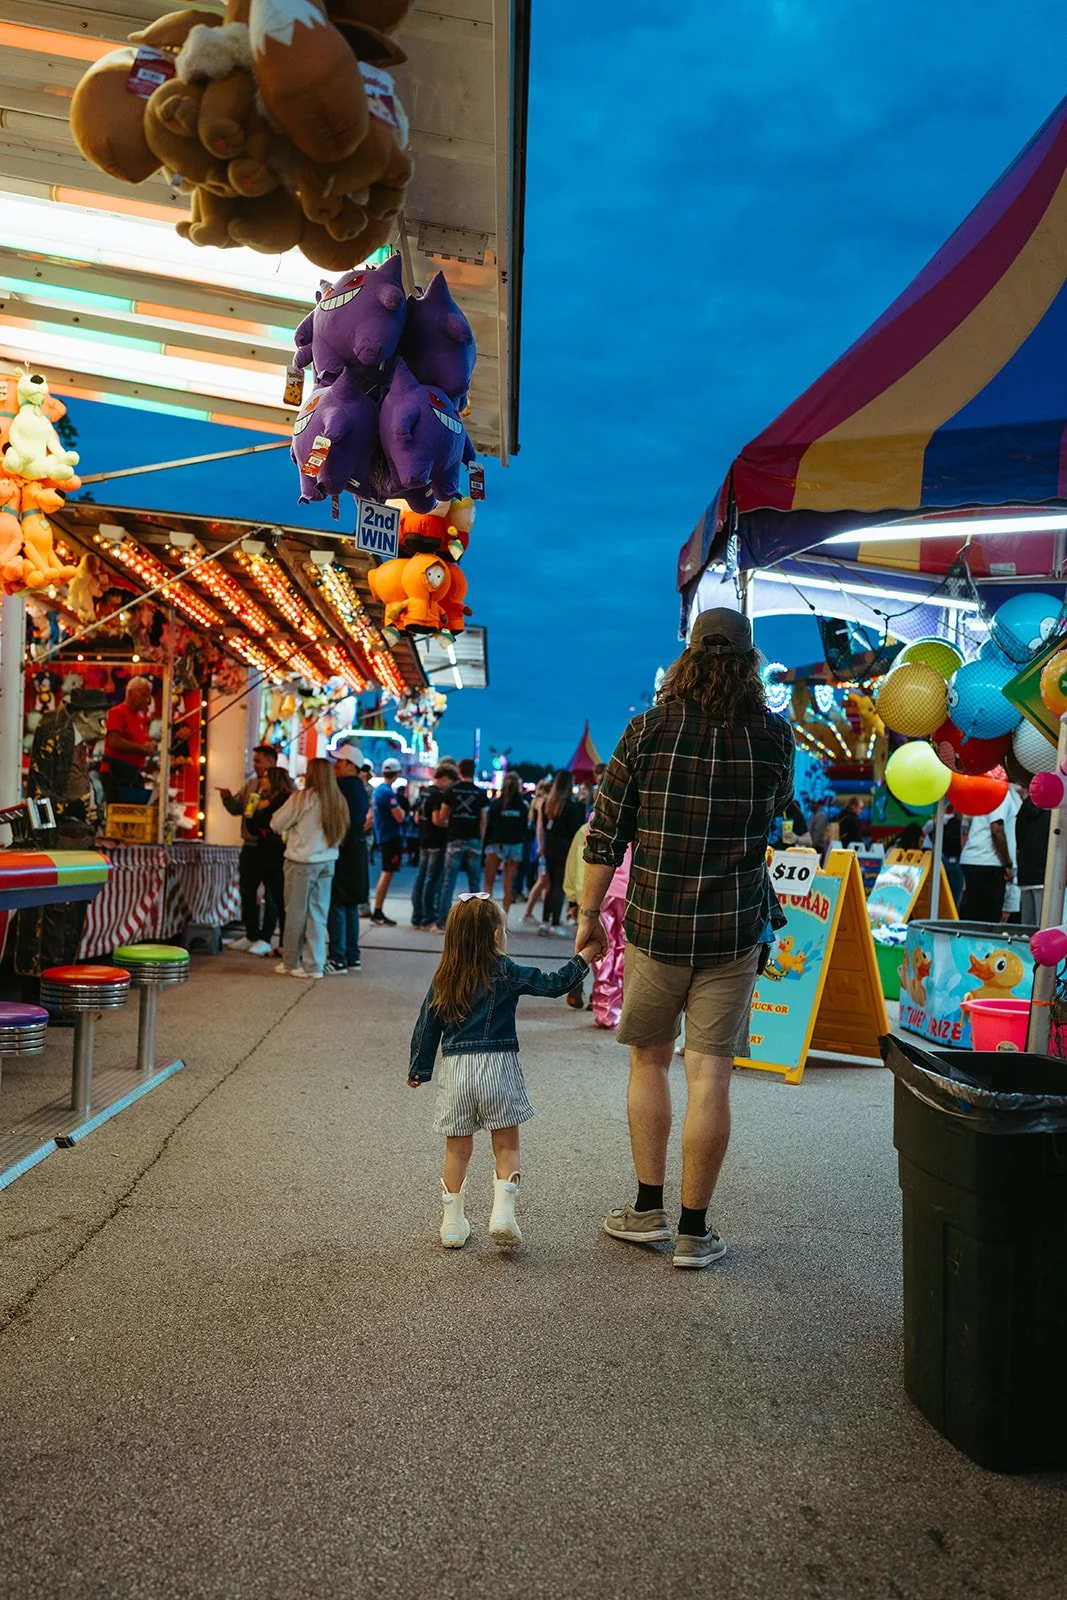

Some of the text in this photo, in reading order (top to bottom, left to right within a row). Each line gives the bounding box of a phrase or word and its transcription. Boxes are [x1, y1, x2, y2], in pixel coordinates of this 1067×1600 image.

[363, 506, 395, 531] 2nd
[361, 526, 396, 553] WIN
[773, 863, 810, 881] $10
[775, 1005, 788, 1015] OR
